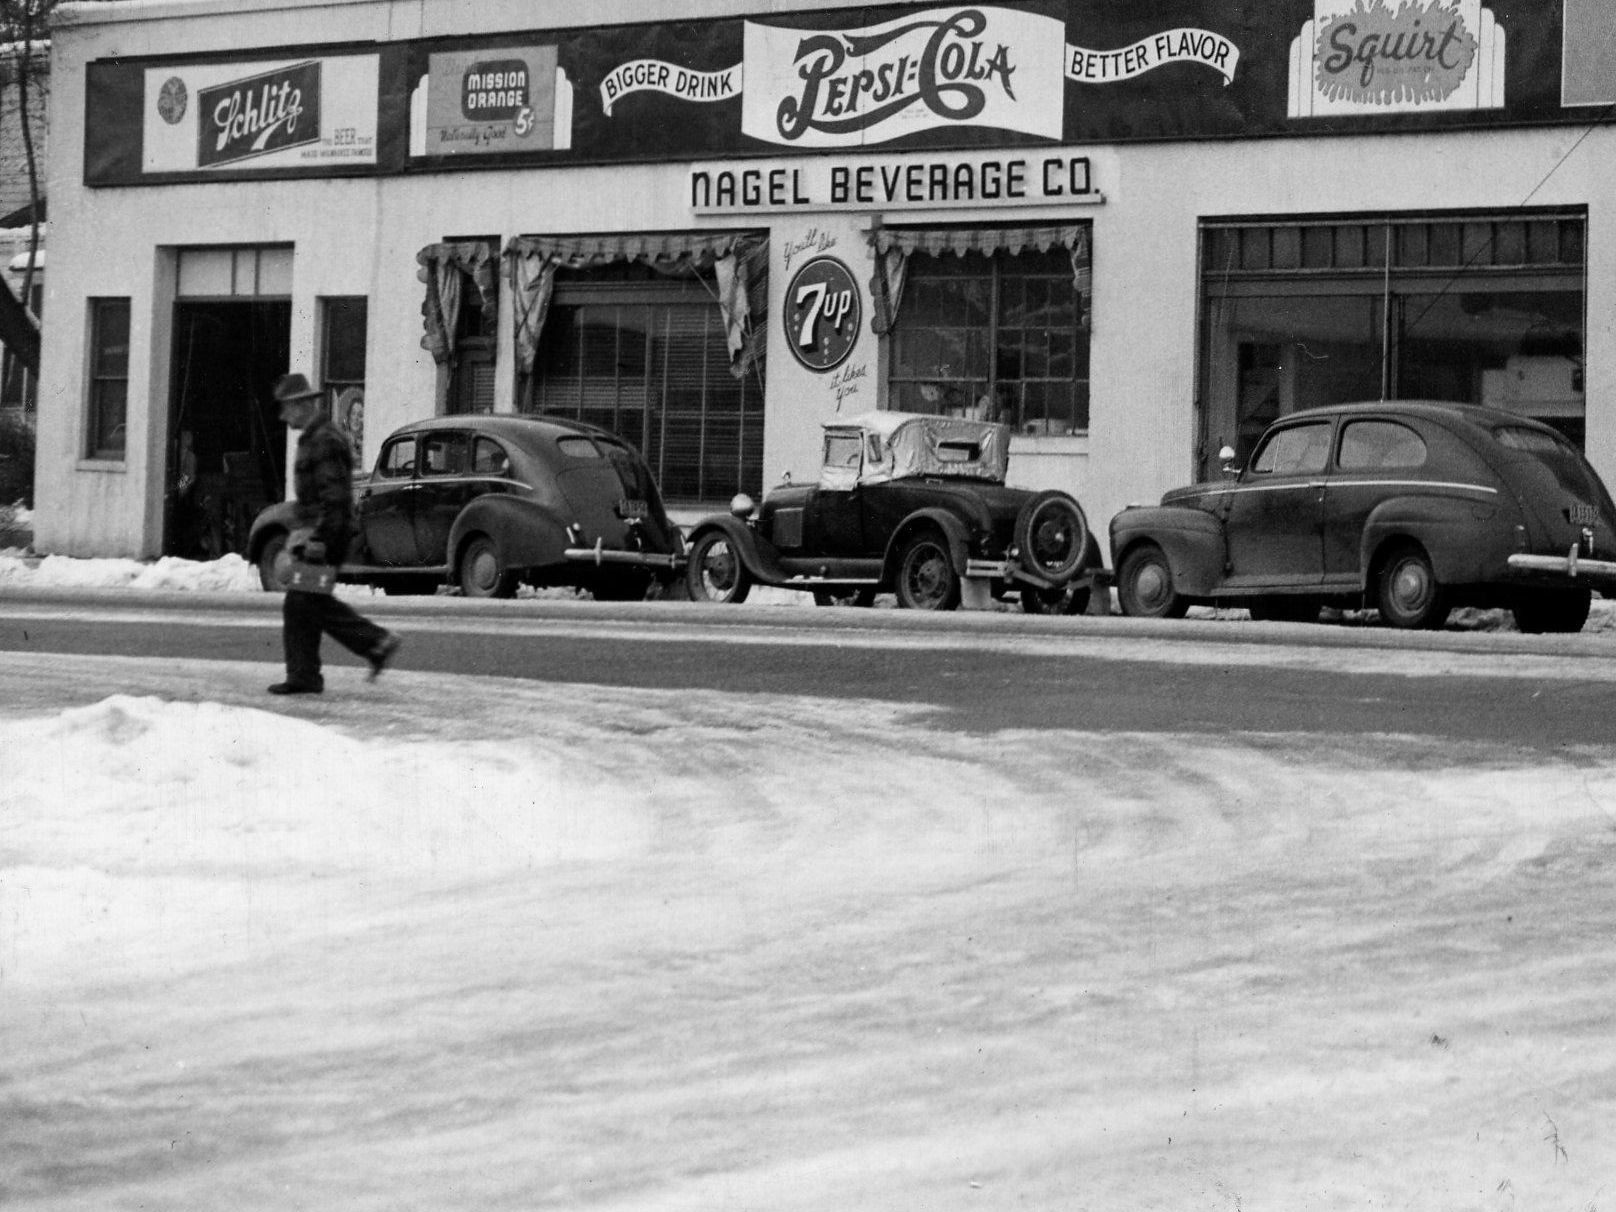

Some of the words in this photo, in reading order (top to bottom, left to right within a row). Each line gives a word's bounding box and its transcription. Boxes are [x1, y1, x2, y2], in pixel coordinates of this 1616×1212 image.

[1071, 43, 1149, 78] BETTER
[1155, 32, 1230, 69] FLAVOR
[1324, 18, 1462, 88] Squirt
[468, 71, 526, 91] MISSION
[605, 63, 670, 100] BIGGER
[674, 71, 733, 98] DRINK
[468, 90, 523, 109] ORANGE
[214, 80, 303, 151] Schlitz
[514, 108, 536, 134] 5¢
[334, 128, 356, 146] BEER
[691, 168, 810, 208] NAGEL
[830, 160, 1026, 204] BEVERAGE
[1042, 156, 1101, 196] CO.
[830, 374, 840, 390] it
[837, 384, 858, 412] you
